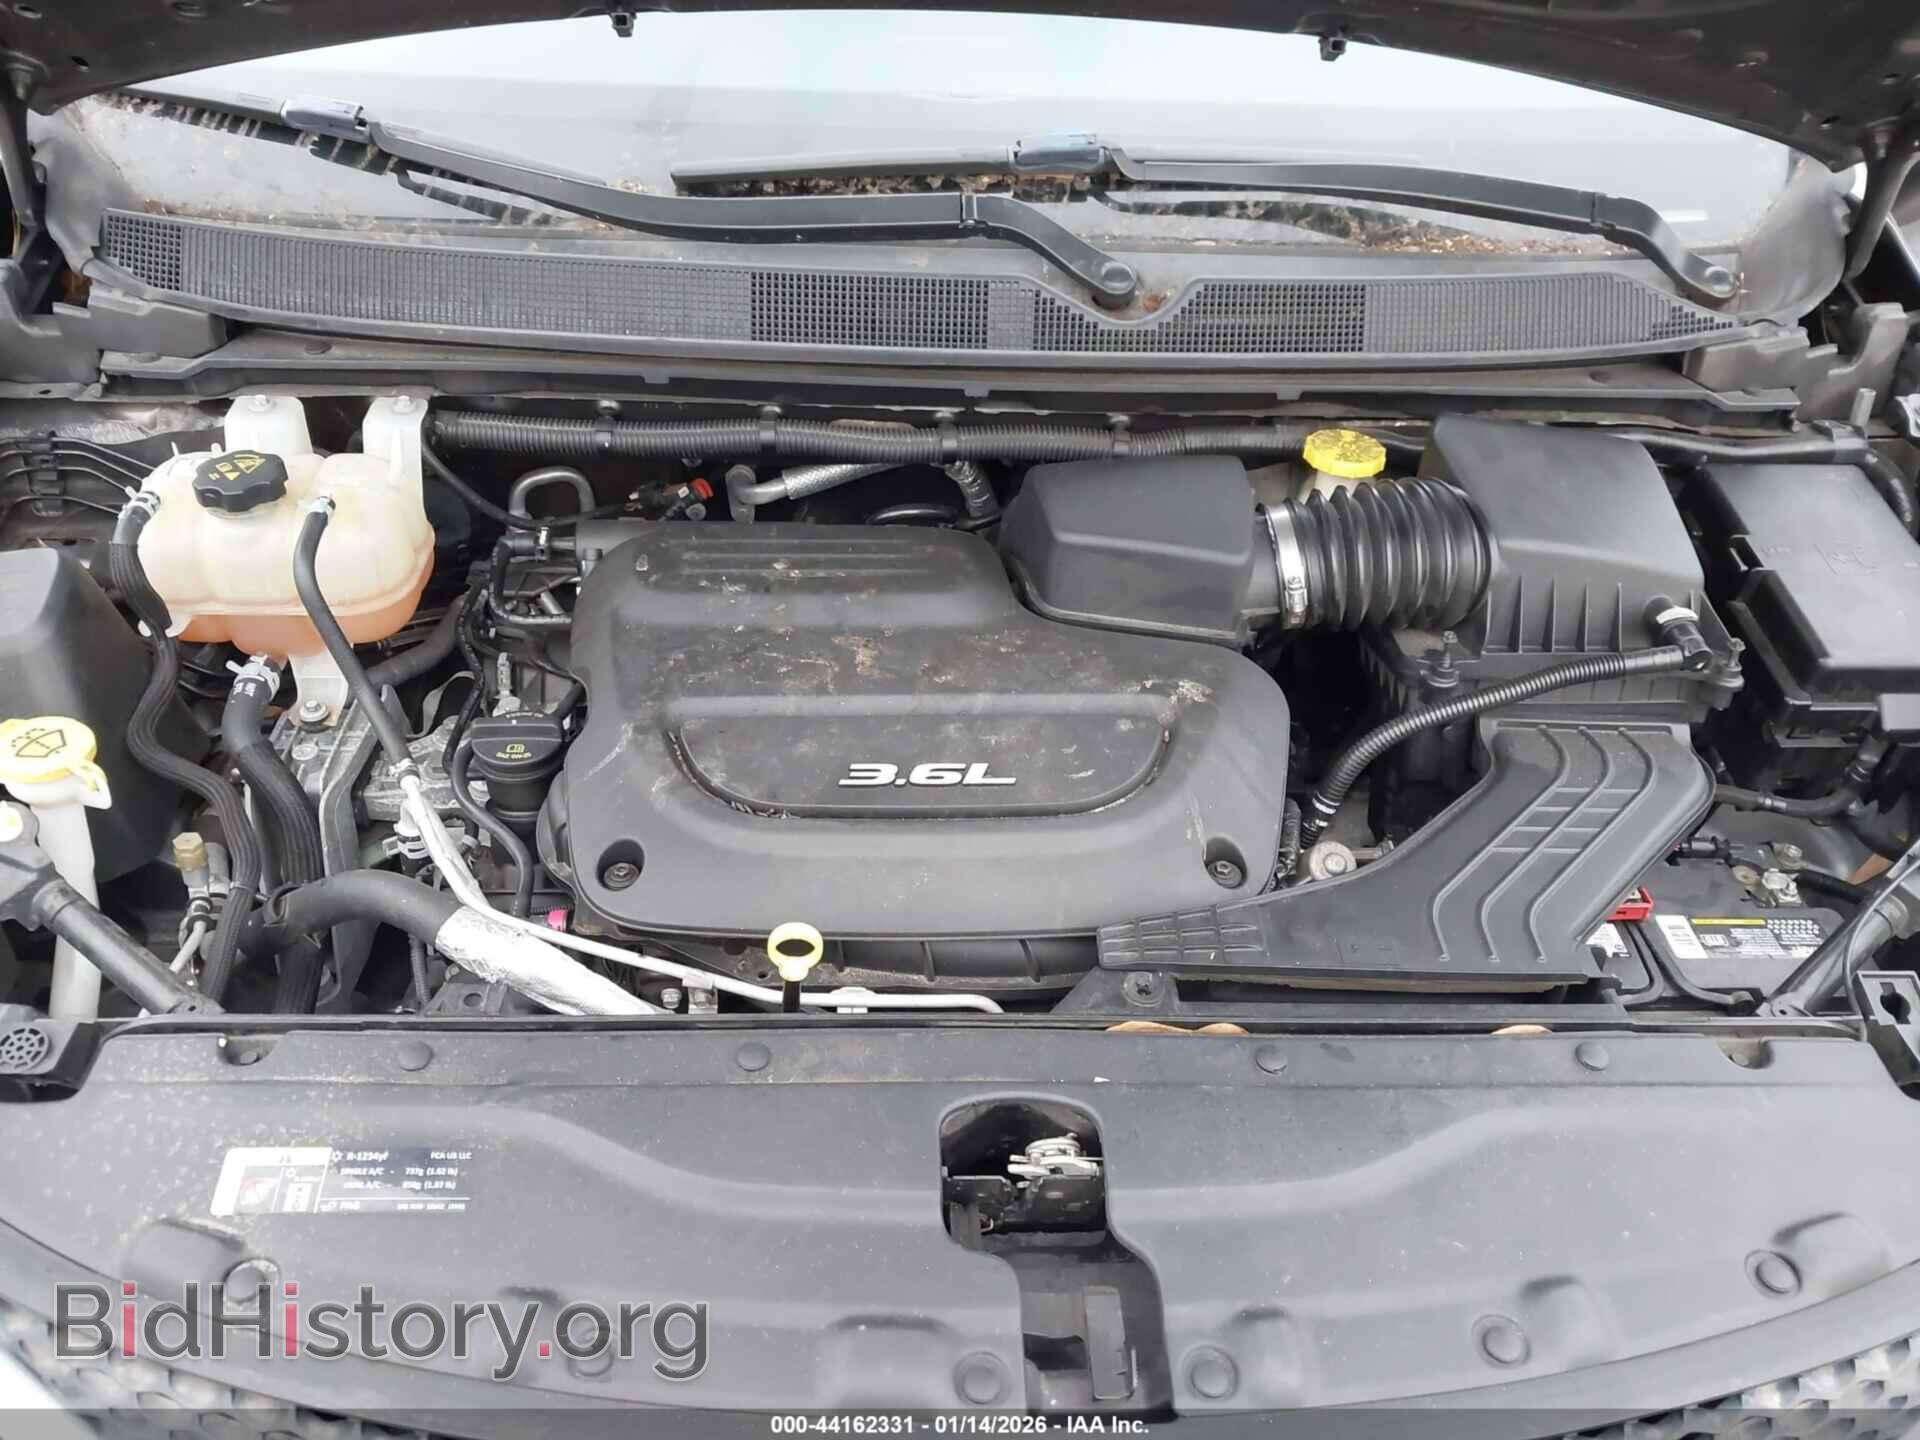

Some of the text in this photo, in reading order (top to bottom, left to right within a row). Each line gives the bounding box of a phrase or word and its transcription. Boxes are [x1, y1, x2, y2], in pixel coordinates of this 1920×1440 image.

[838, 763, 1017, 786] 3.6L
[431, 1152, 445, 1160] FCA
[459, 1152, 472, 1160] LLC
